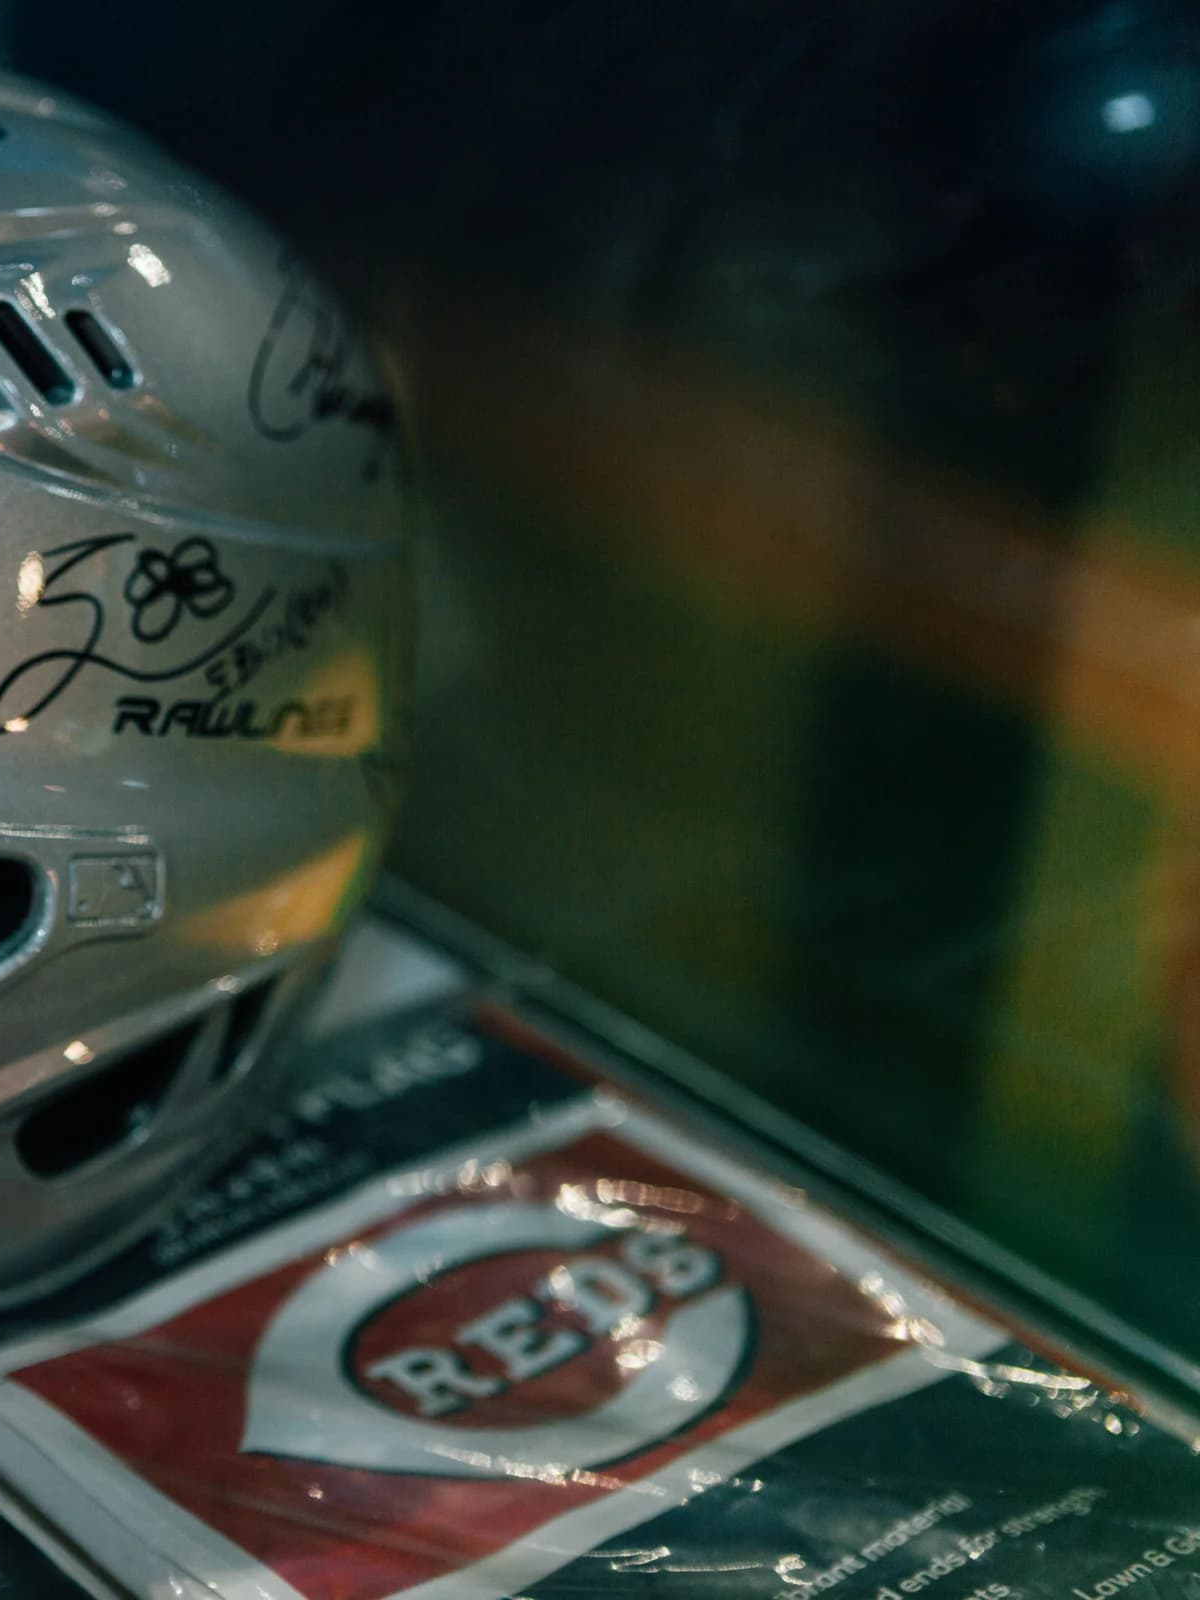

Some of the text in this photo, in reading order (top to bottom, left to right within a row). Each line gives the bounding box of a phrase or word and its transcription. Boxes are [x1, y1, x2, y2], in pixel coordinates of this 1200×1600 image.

[365, 1233, 725, 1416] REDS
[900, 1551, 968, 1593] ends
[1071, 1563, 1153, 1600] Lawn
[1142, 1549, 1176, 1568] &
